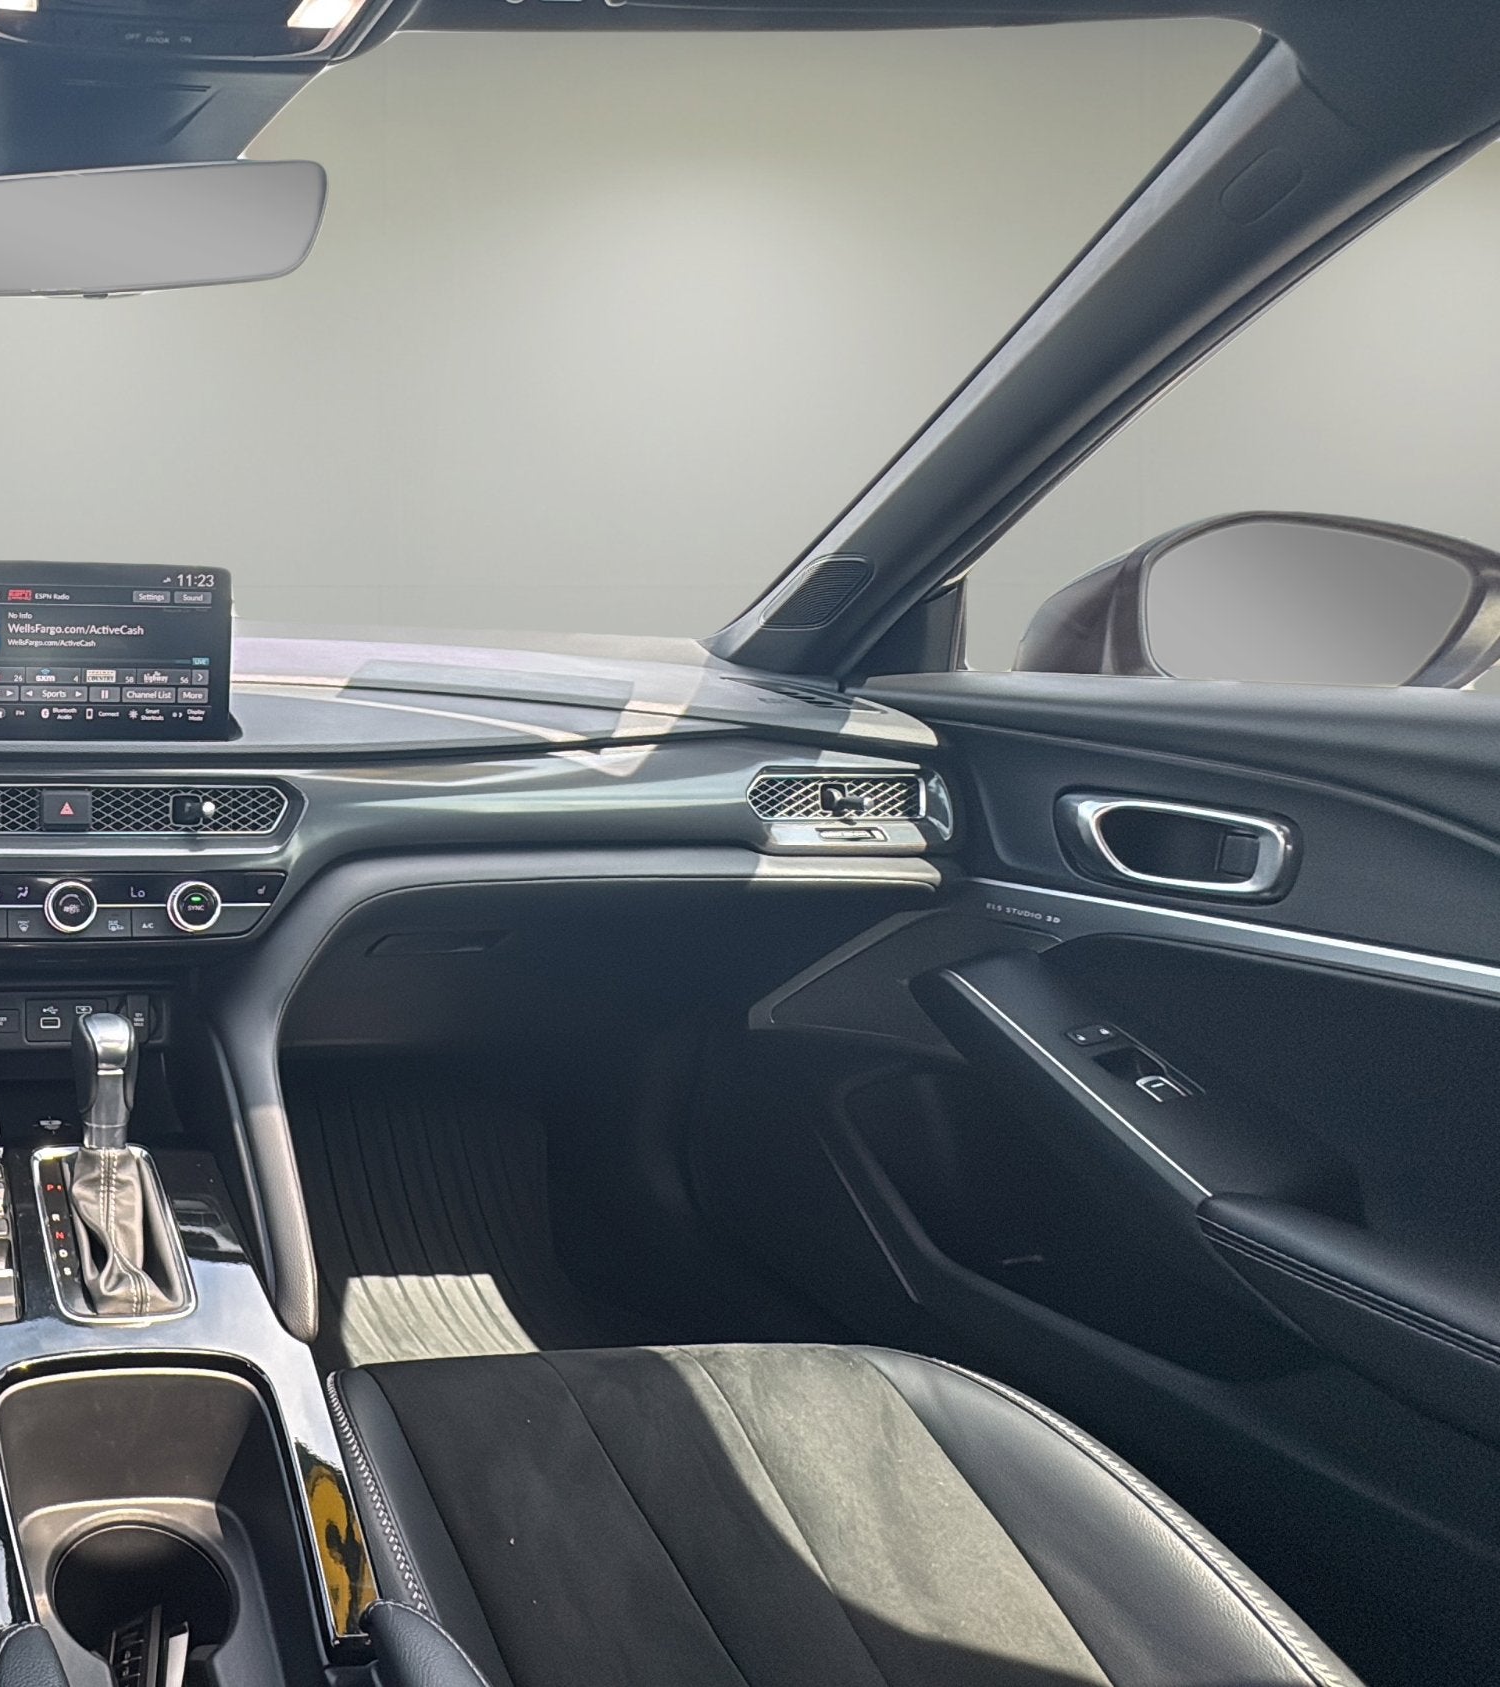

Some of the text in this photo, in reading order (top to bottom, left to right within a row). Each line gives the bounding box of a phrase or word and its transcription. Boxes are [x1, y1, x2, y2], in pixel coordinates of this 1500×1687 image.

[177, 574, 215, 587] 11:23
[138, 592, 165, 602] Settings
[182, 593, 203, 602] Sound
[8, 623, 144, 636] WellsFargo.com/ActiveCash
[7, 639, 96, 647] WellsFargo.com/ActiveCash
[73, 675, 79, 683] 4
[125, 676, 135, 684] 58
[180, 676, 189, 684] 56
[42, 690, 67, 699] Sports
[126, 690, 172, 699] Channel List
[182, 691, 203, 699] More
[130, 886, 146, 898] Lo
[1005, 906, 1043, 920] STUDIO
[1046, 915, 1061, 924] 3D
[46, 1183, 54, 1191] P
[52, 1213, 60, 1222] R
[55, 1231, 65, 1240] N
